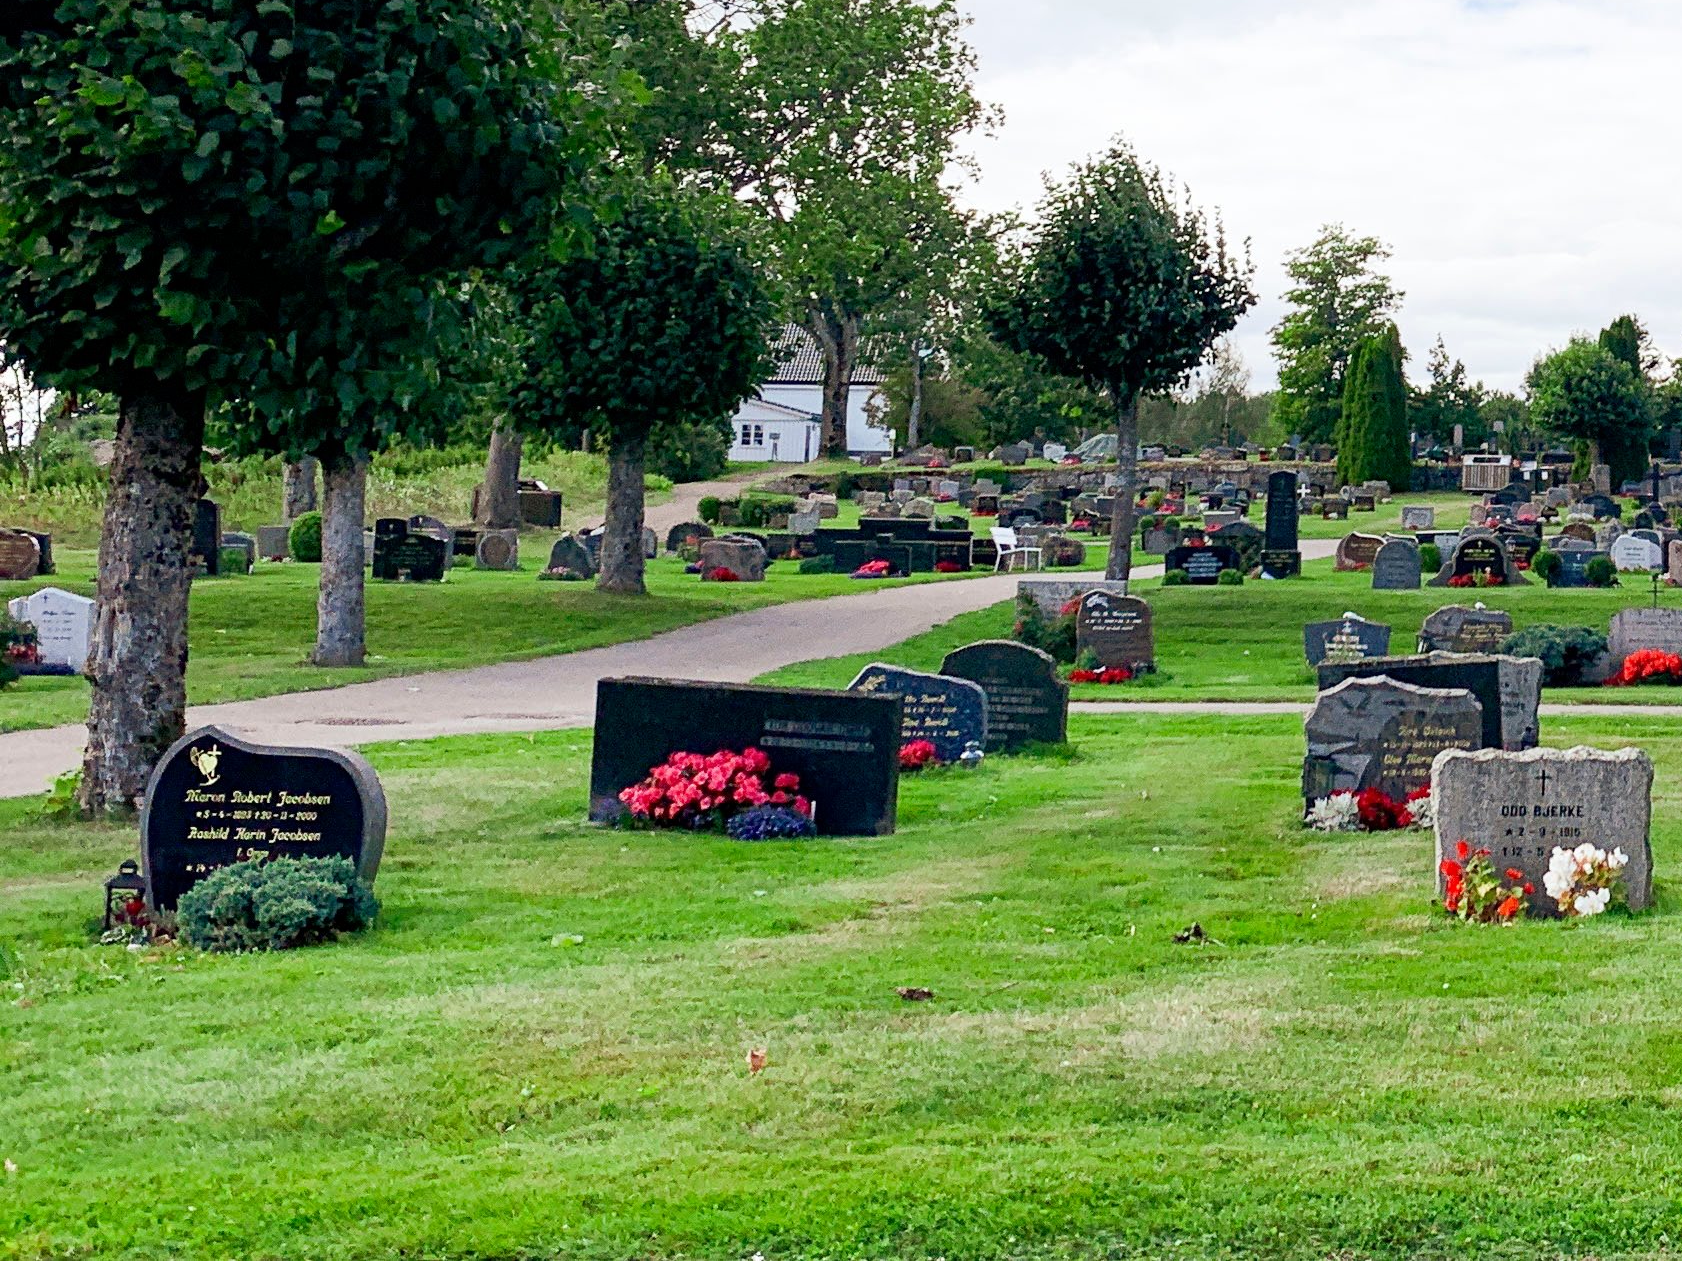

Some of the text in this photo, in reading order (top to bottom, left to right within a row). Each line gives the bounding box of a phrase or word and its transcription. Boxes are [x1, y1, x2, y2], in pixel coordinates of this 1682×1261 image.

[231, 791, 272, 803] Robert
[276, 791, 330, 806] Jacobsen
[1502, 805, 1584, 817] ODD BJERKE
[268, 828, 321, 843] Jacobsen
